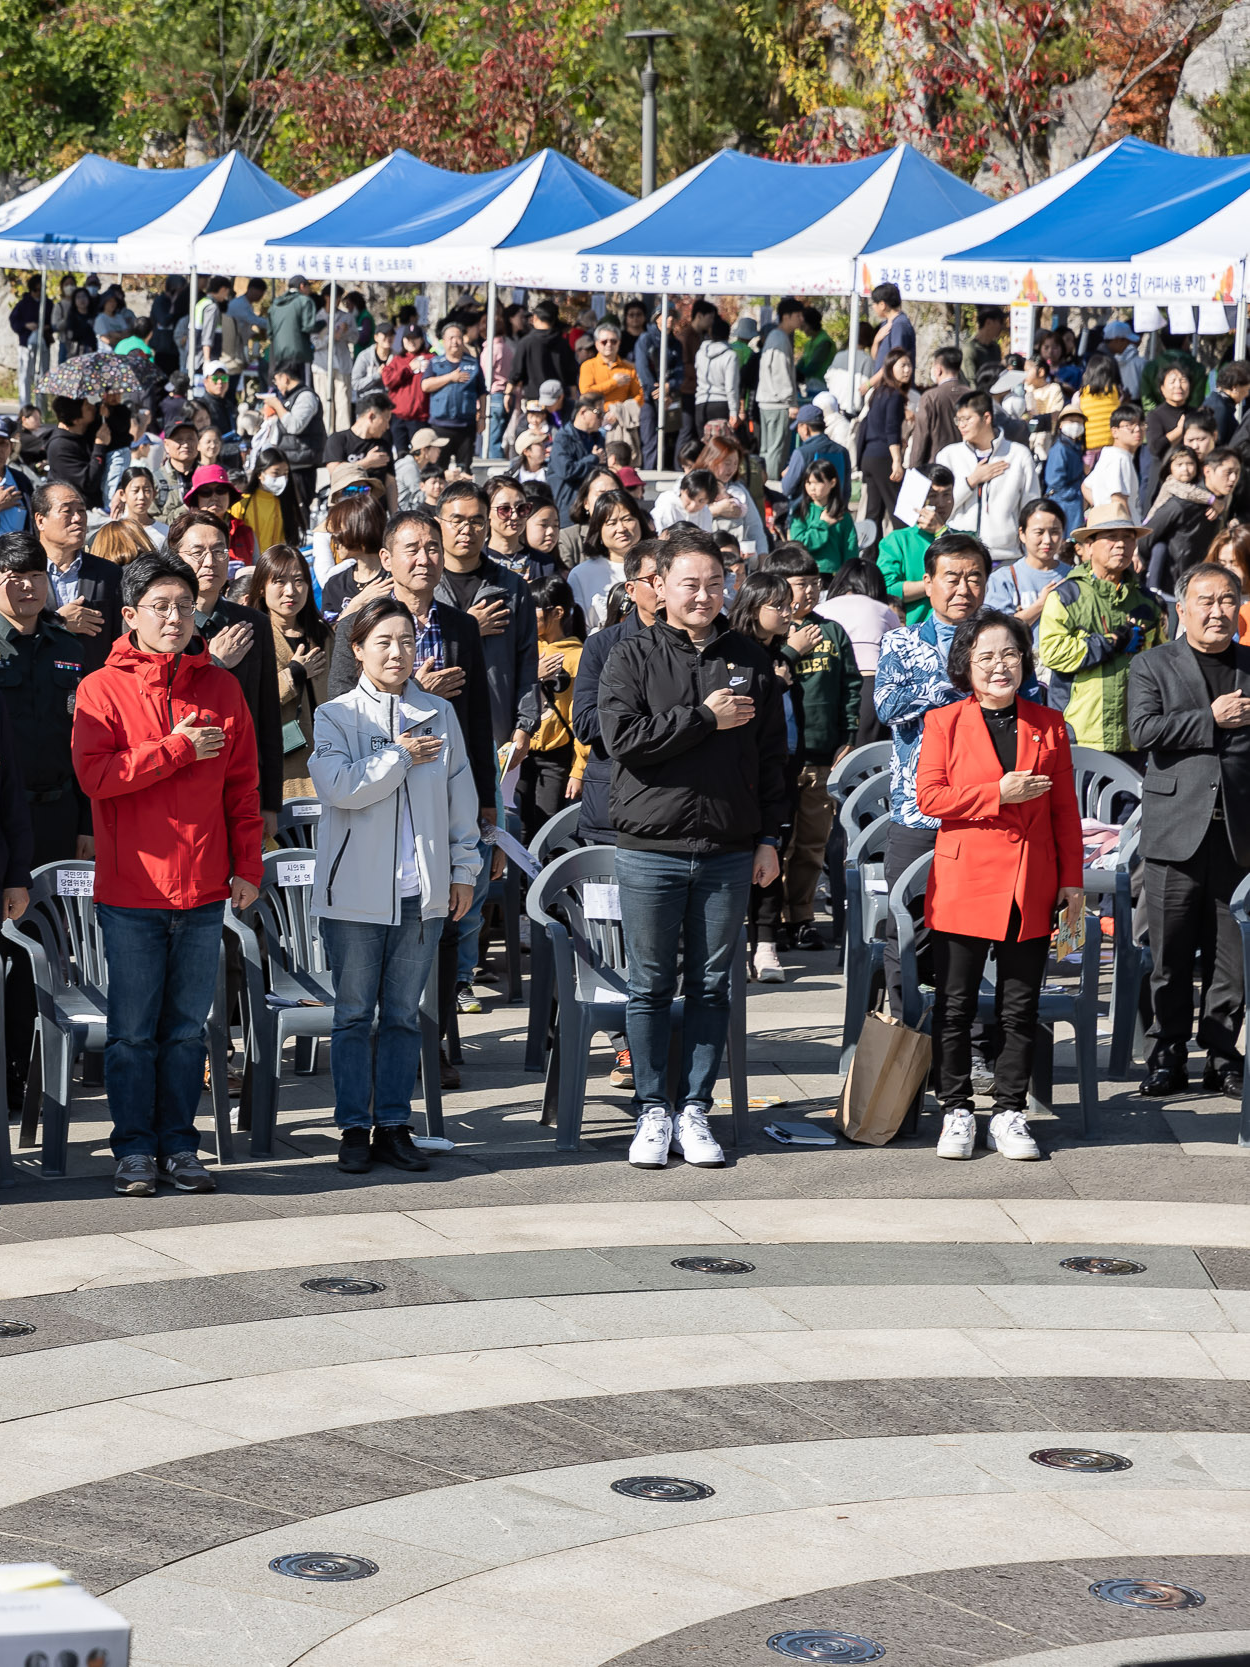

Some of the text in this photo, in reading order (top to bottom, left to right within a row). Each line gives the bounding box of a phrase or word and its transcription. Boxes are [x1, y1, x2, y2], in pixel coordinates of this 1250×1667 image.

[254, 253, 287, 272] 광장동
[298, 254, 371, 274] 새마을부녀회
[580, 263, 620, 284] 광장동
[629, 264, 719, 287] 자원봉사캠프
[915, 269, 949, 294] 상인회
[1055, 273, 1094, 298] 광장동
[1101, 273, 1141, 298] 상인회
[63, 871, 89, 879] 국민의힘
